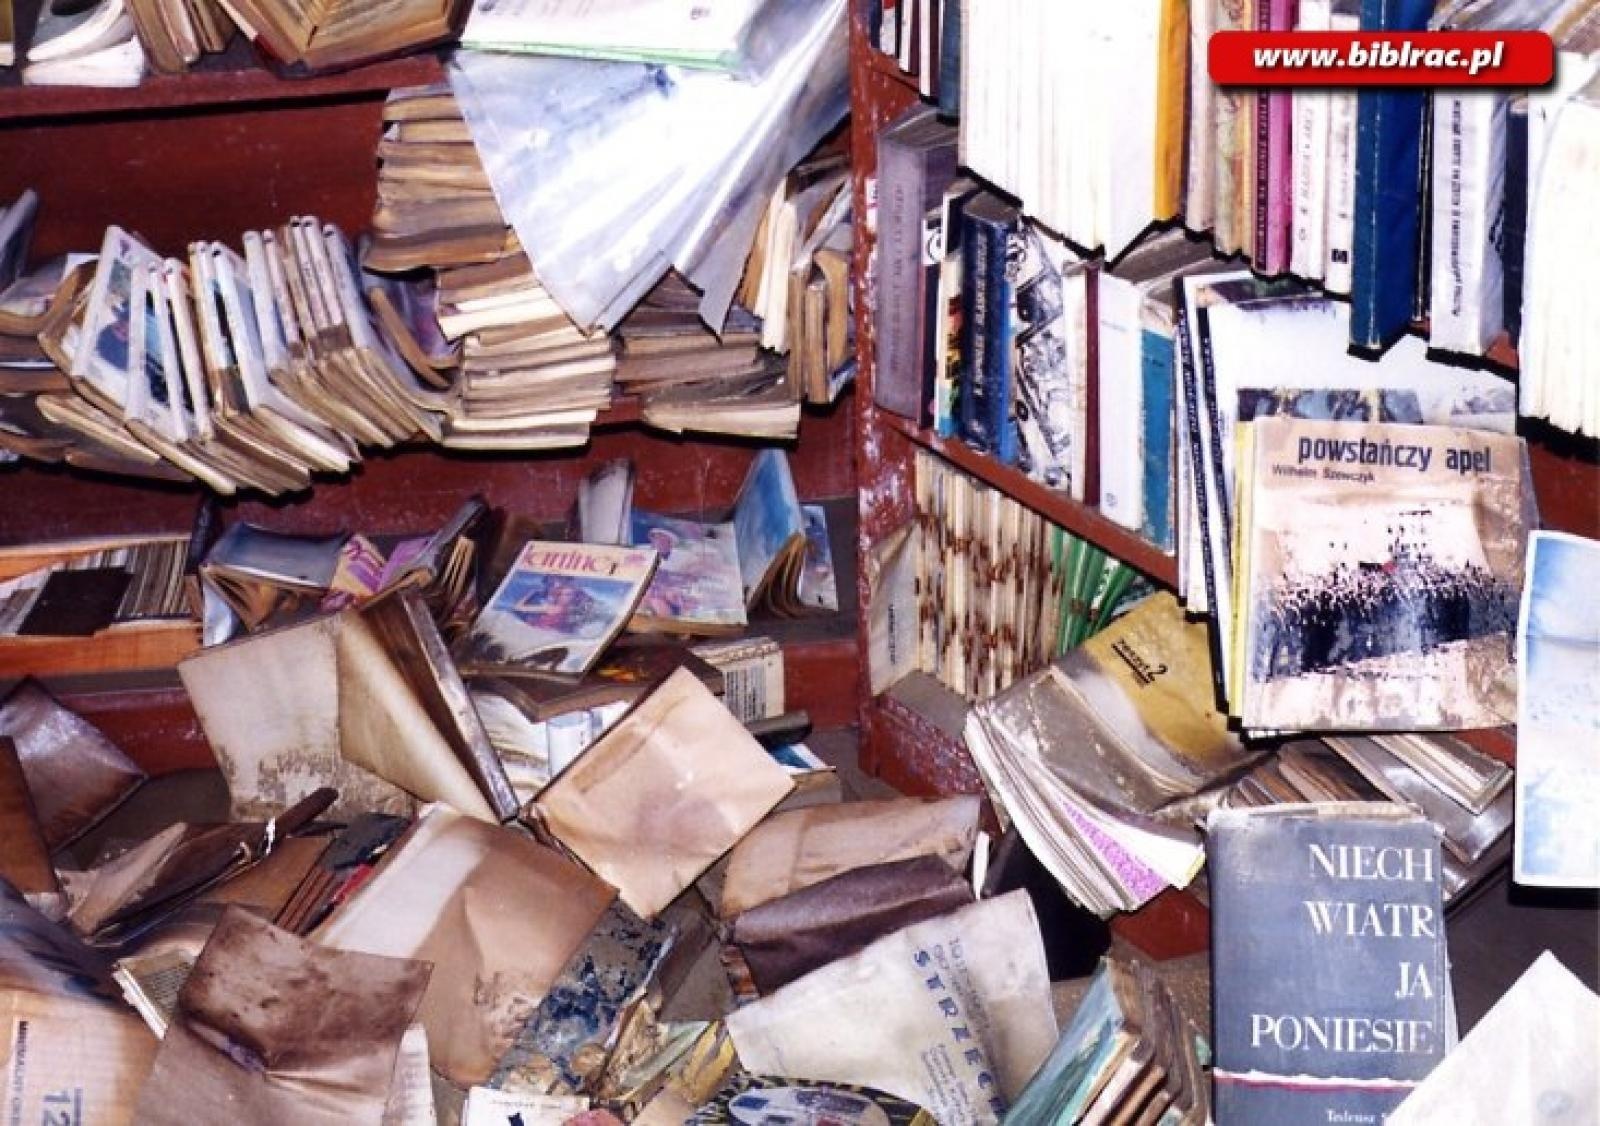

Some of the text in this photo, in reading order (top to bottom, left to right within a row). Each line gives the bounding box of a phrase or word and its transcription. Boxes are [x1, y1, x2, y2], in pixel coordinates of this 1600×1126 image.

[1271, 464, 1376, 485] Wilhelm Szewczyk
[1298, 436, 1491, 475] powstańczy apel
[1308, 843, 1434, 883] NIECH
[1303, 900, 1435, 939] WIATR
[1394, 961, 1434, 999] JA
[1251, 1013, 1434, 1055] PONIESIE
